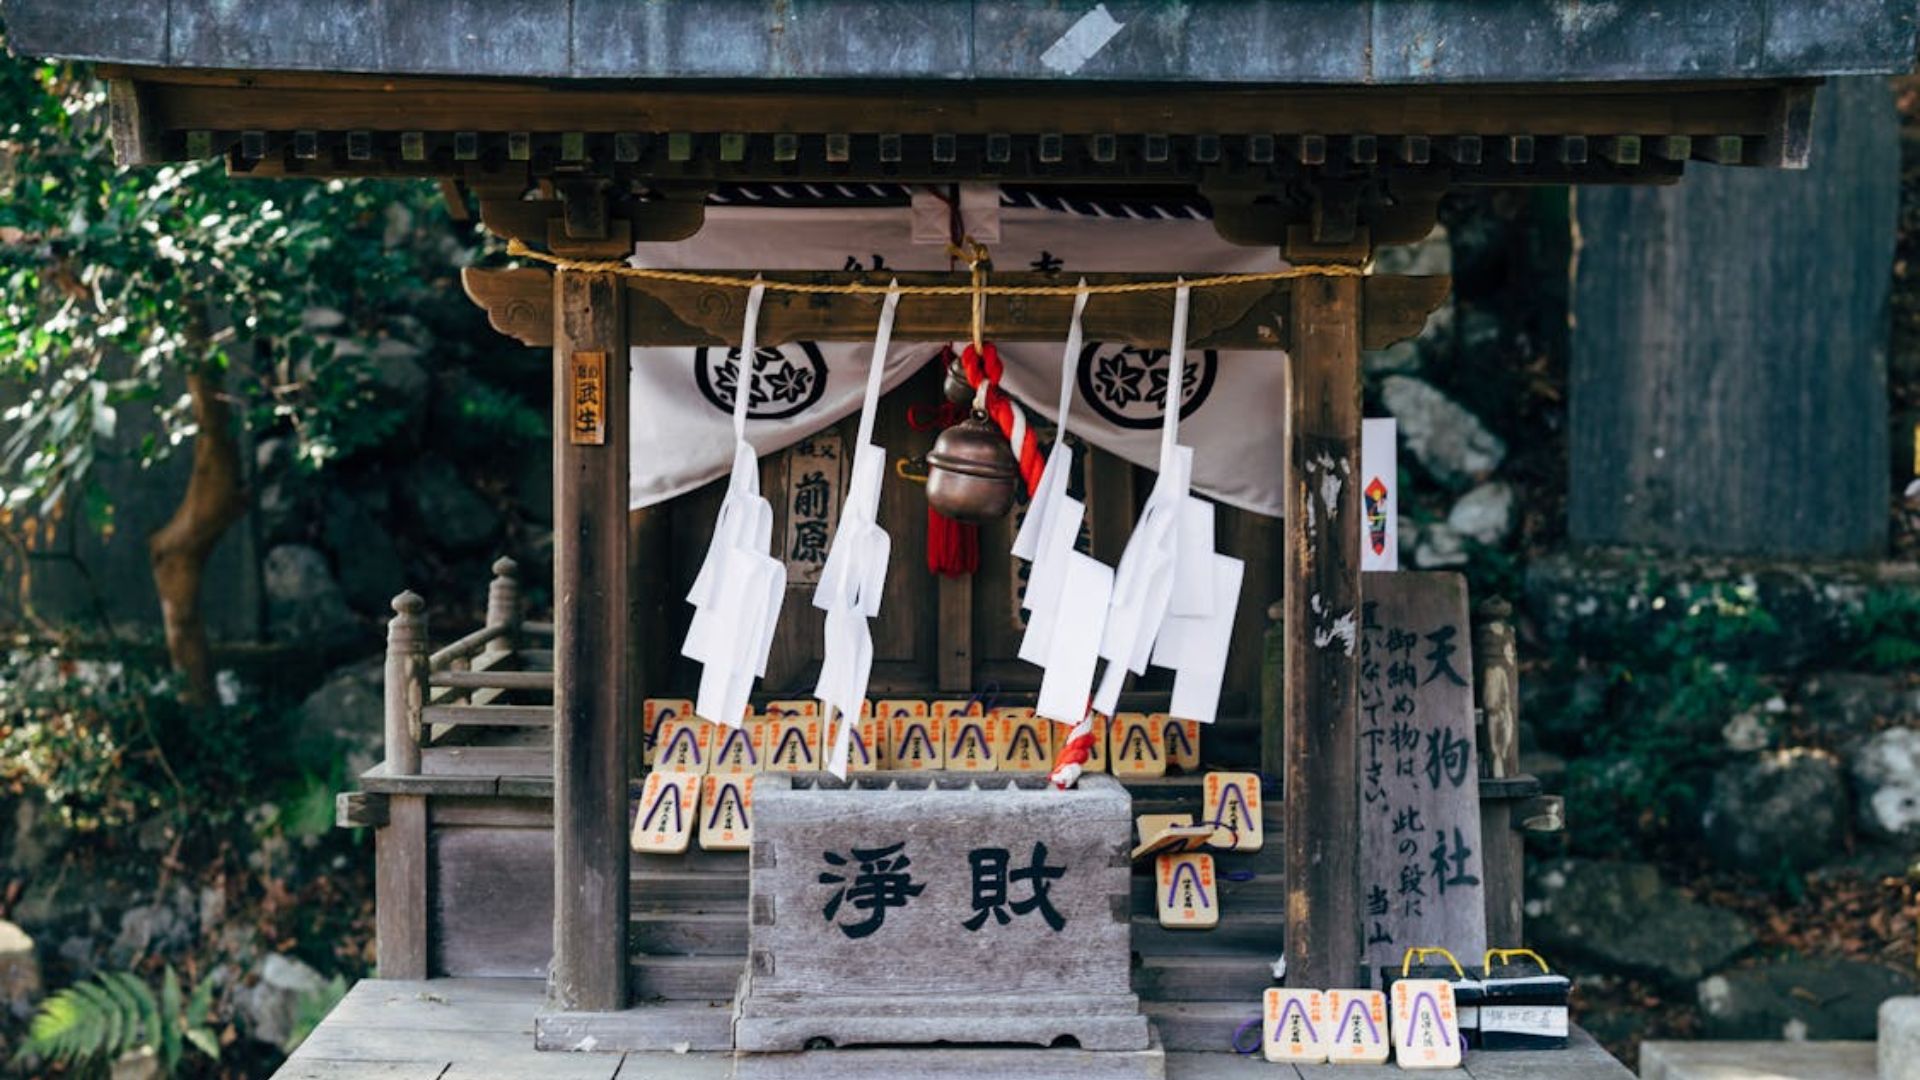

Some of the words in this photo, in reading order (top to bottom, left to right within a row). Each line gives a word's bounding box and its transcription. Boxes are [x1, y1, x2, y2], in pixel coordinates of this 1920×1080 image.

[792, 471, 830, 563] 前原
[1422, 625, 1480, 895] 天狗社
[1368, 884, 1393, 945] 当山
